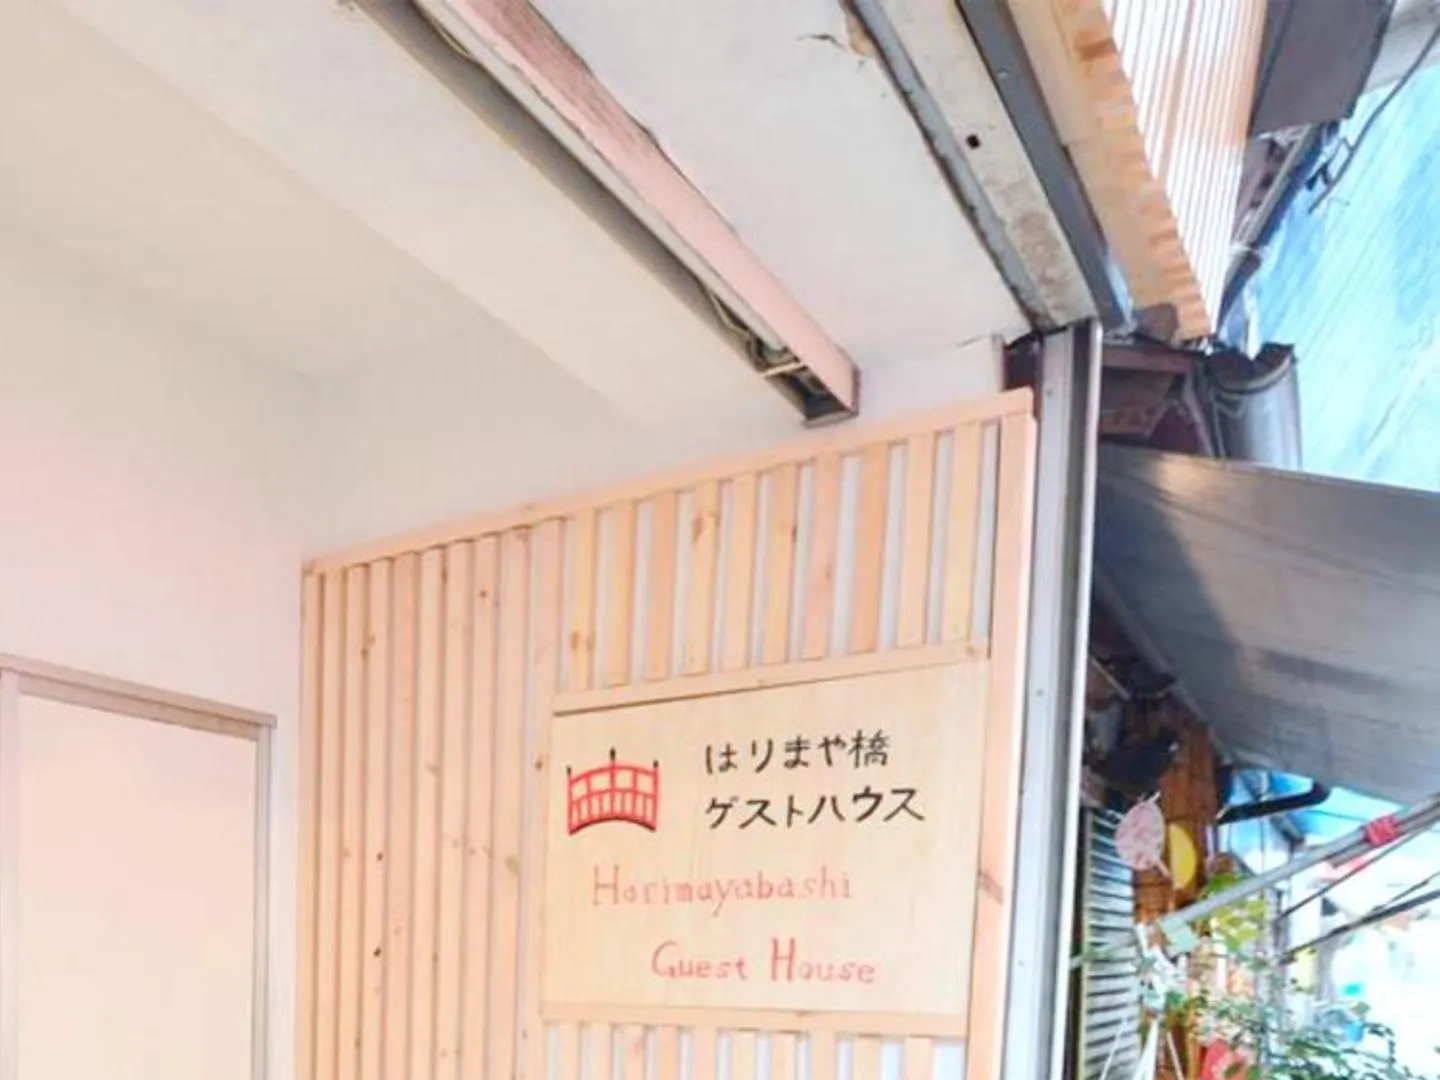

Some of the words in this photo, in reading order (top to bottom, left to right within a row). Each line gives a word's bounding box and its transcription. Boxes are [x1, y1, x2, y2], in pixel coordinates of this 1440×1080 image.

[705, 730, 890, 774] はりまや橋
[705, 786, 925, 829] ゲストハウス
[591, 864, 853, 917] Harimayabashi
[651, 941, 748, 980] Guest
[770, 938, 876, 984] House
